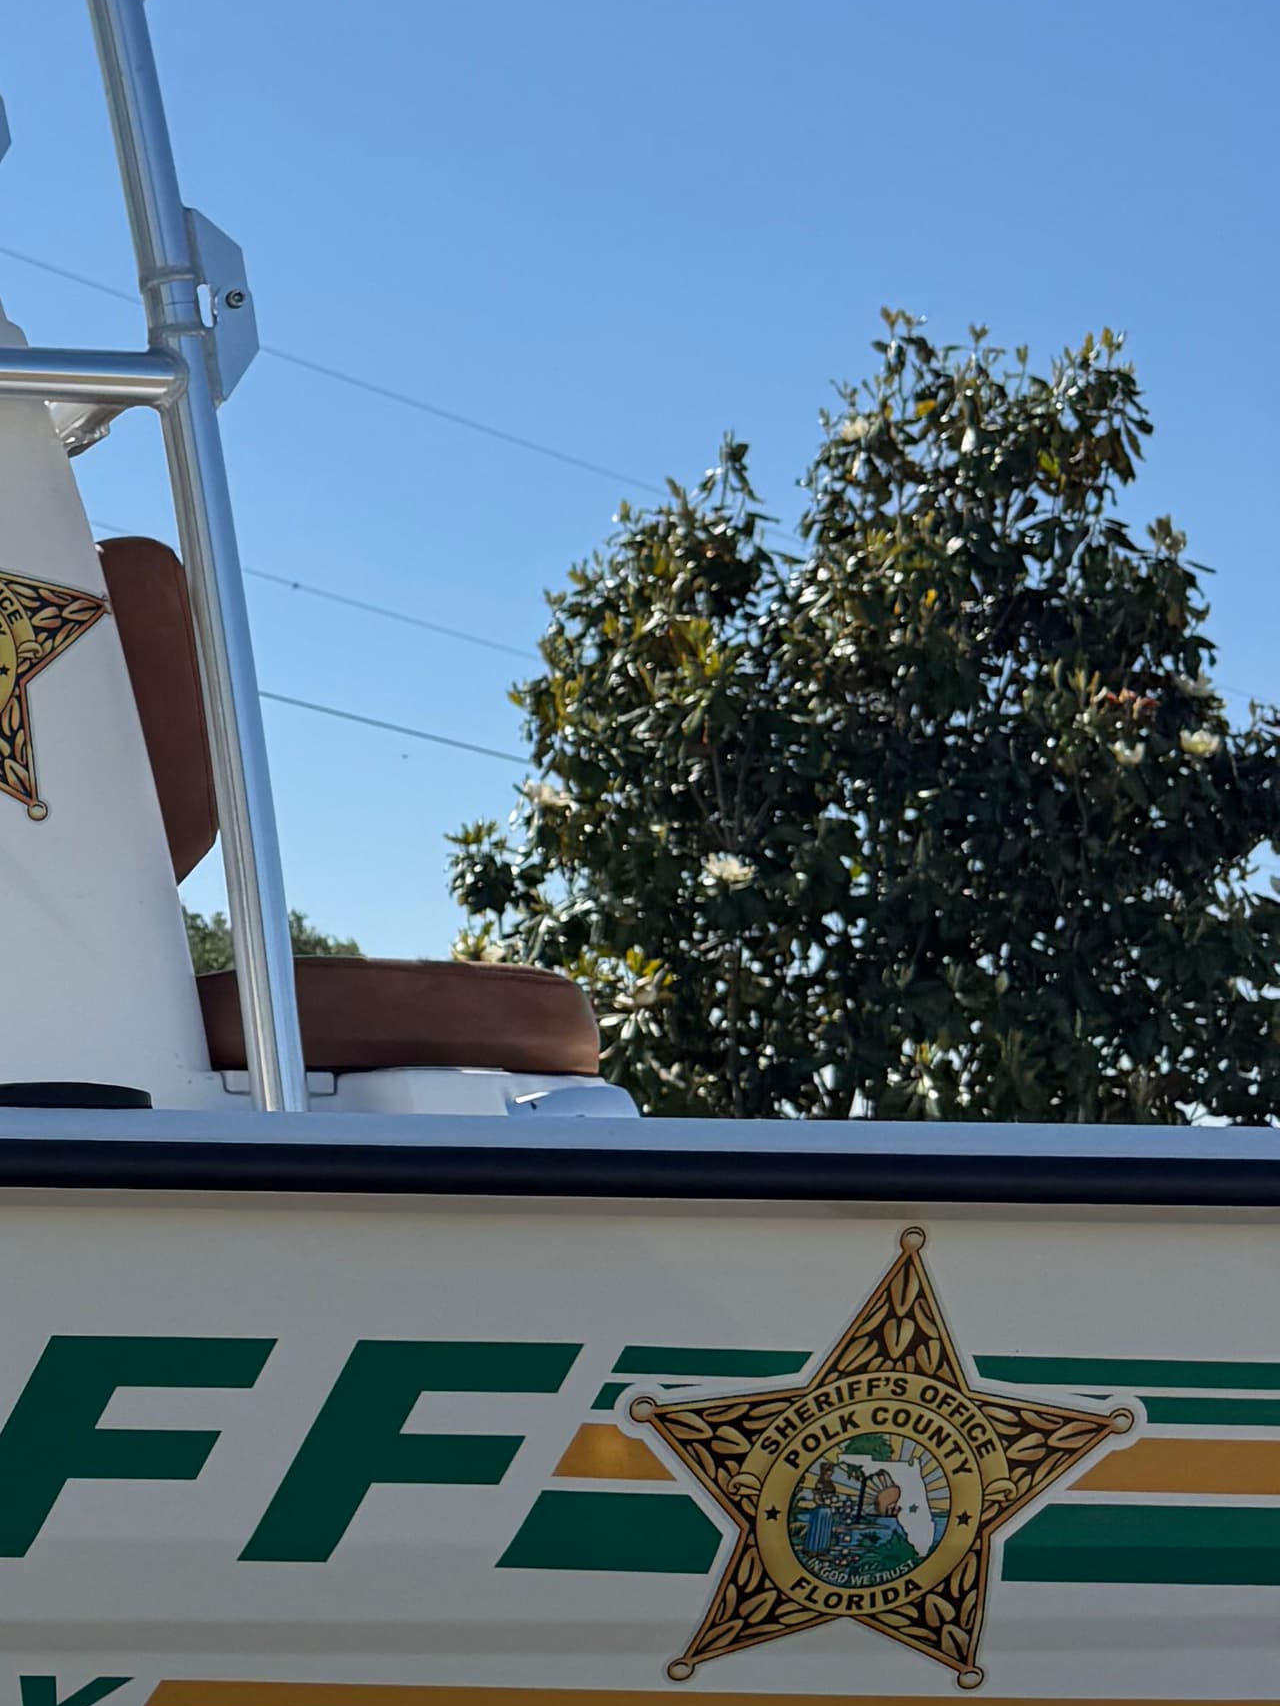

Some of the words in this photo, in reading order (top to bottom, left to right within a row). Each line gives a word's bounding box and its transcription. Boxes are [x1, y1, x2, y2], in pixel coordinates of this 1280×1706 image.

[759, 1376, 910, 1456] SHERIFF'S
[918, 1383, 998, 1460] OFFICE
[782, 1408, 862, 1471] POLK
[870, 1406, 974, 1479] COUNTY
[789, 1575, 923, 1611] FLORIDA
[820, 1565, 849, 1583] GOD
[850, 1574, 872, 1586] WE
[874, 1558, 916, 1583] TRUST
